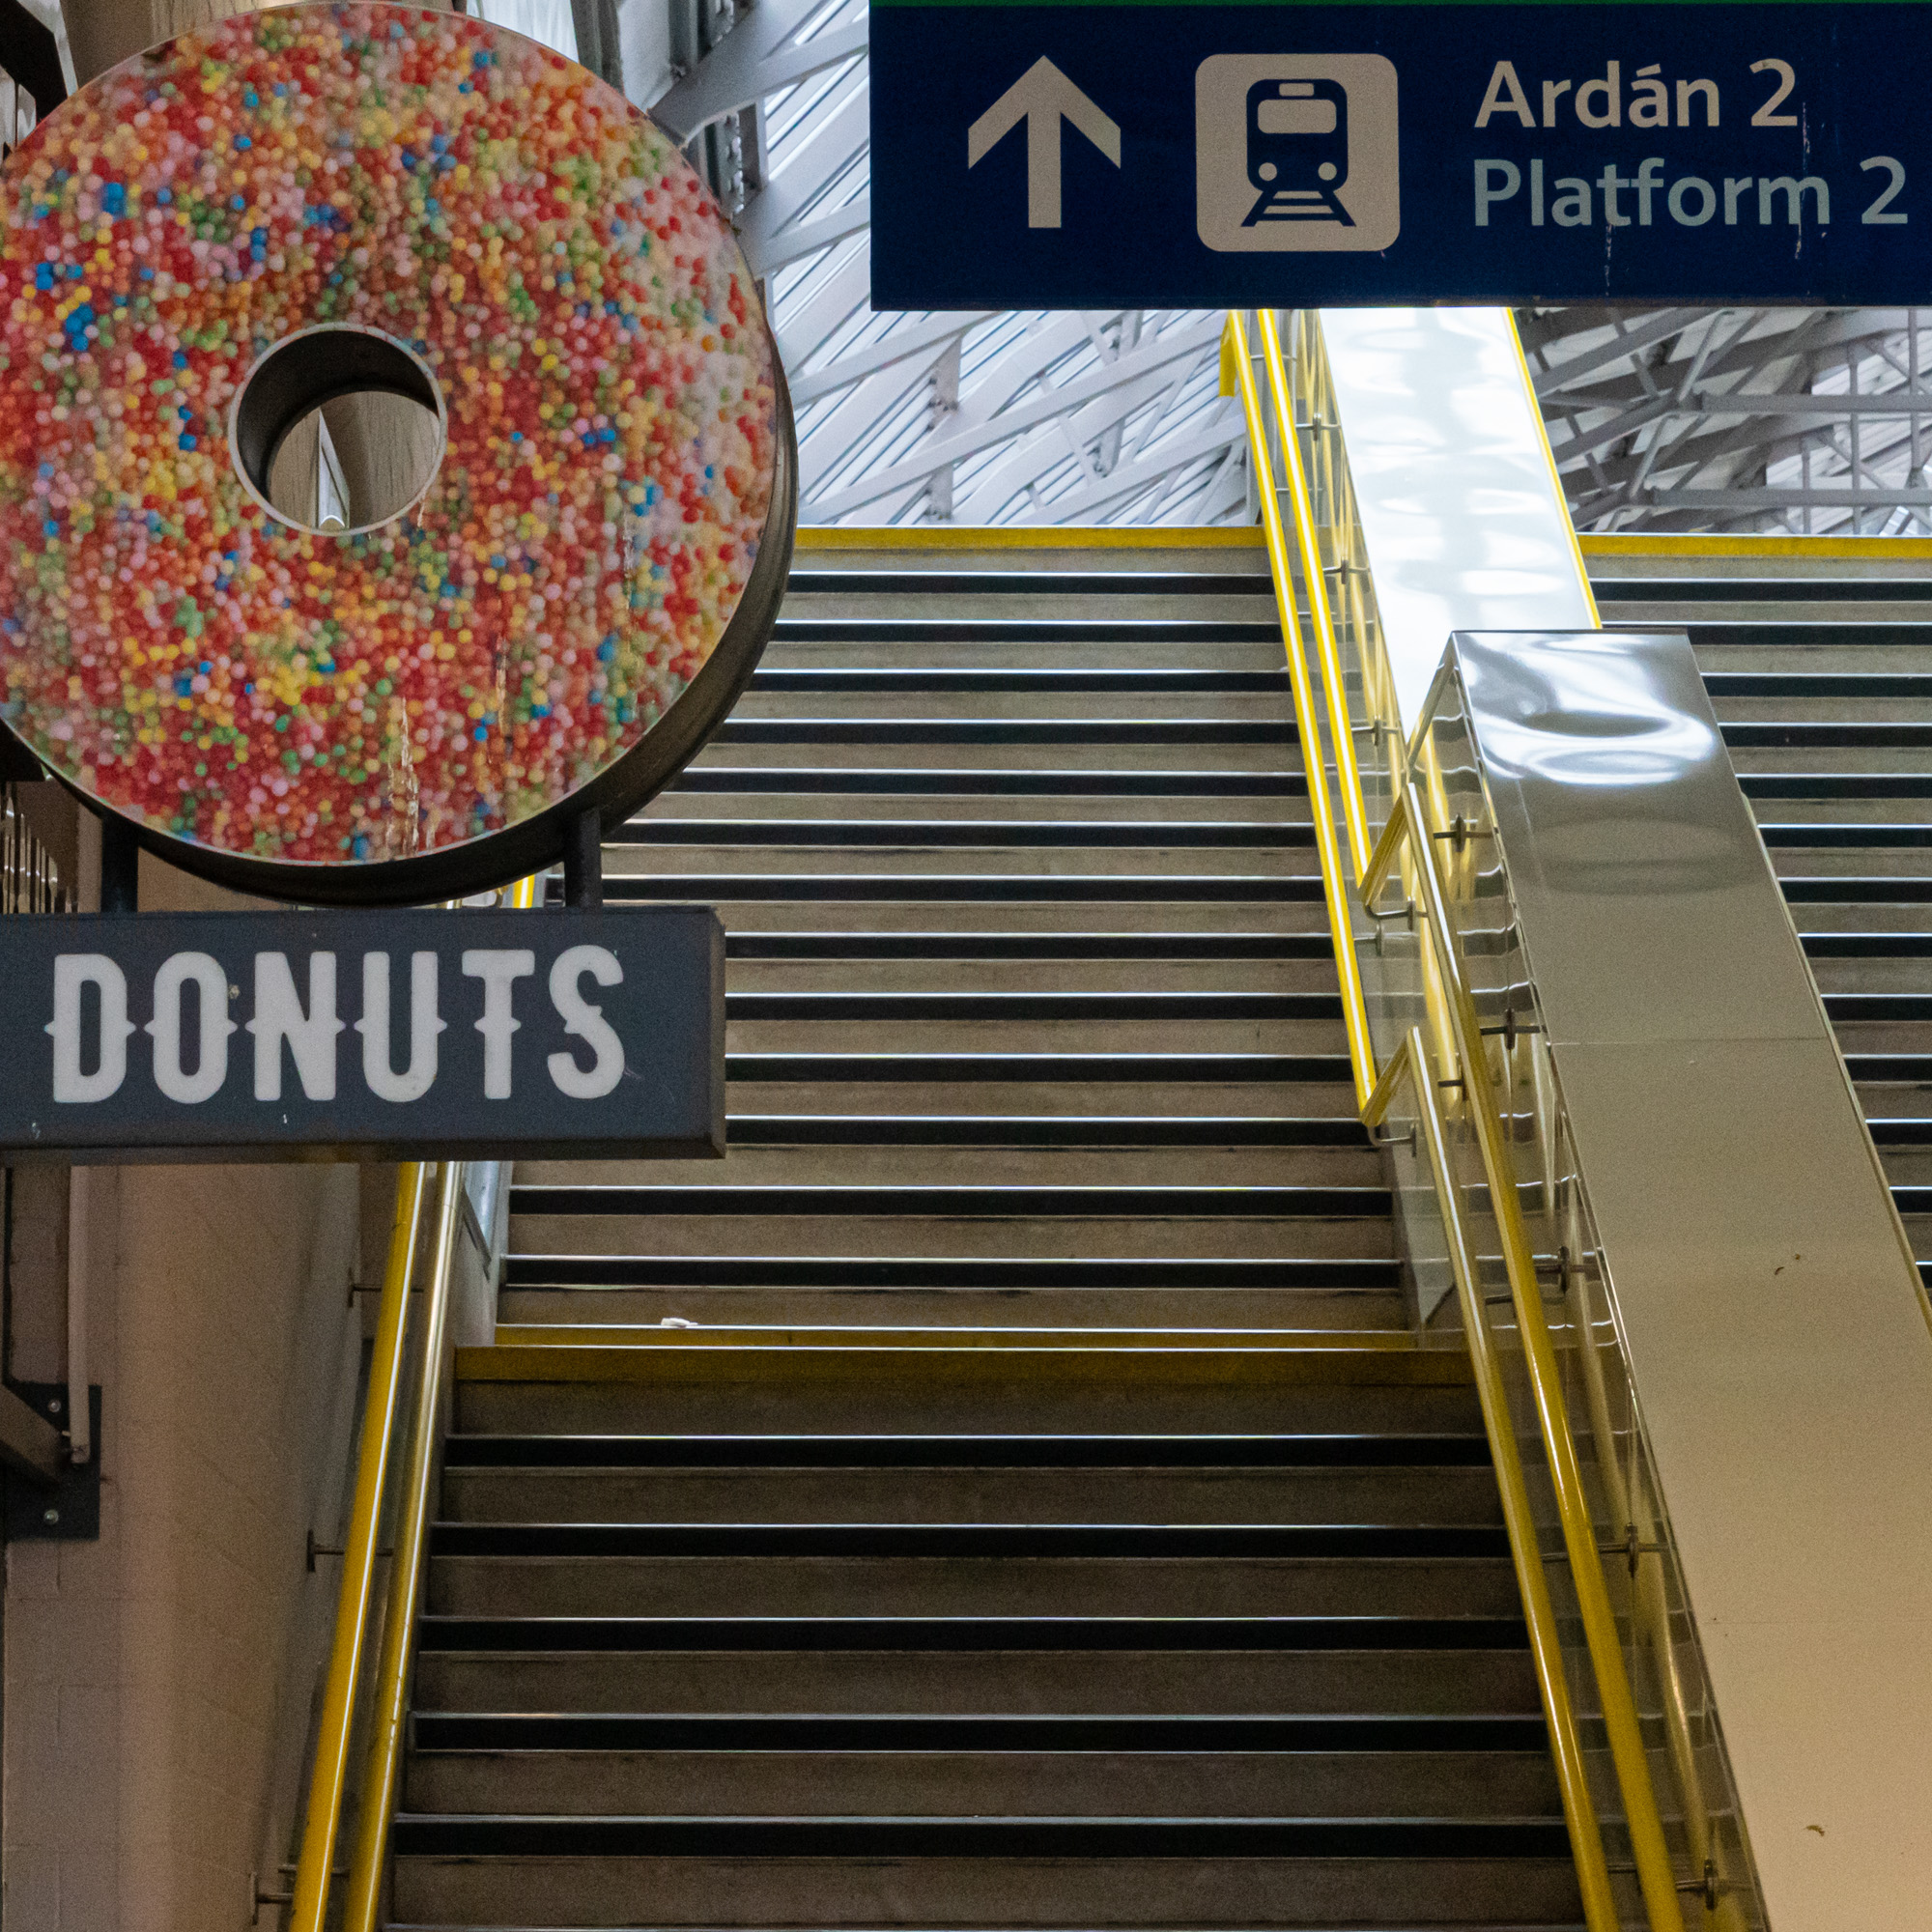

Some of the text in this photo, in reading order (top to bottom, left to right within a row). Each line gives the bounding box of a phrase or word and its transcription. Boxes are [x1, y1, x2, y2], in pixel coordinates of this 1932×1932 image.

[1474, 58, 1799, 128] Ardán 2
[1473, 156, 1909, 227] Platform 2
[44, 944, 626, 1104] DONUTS
